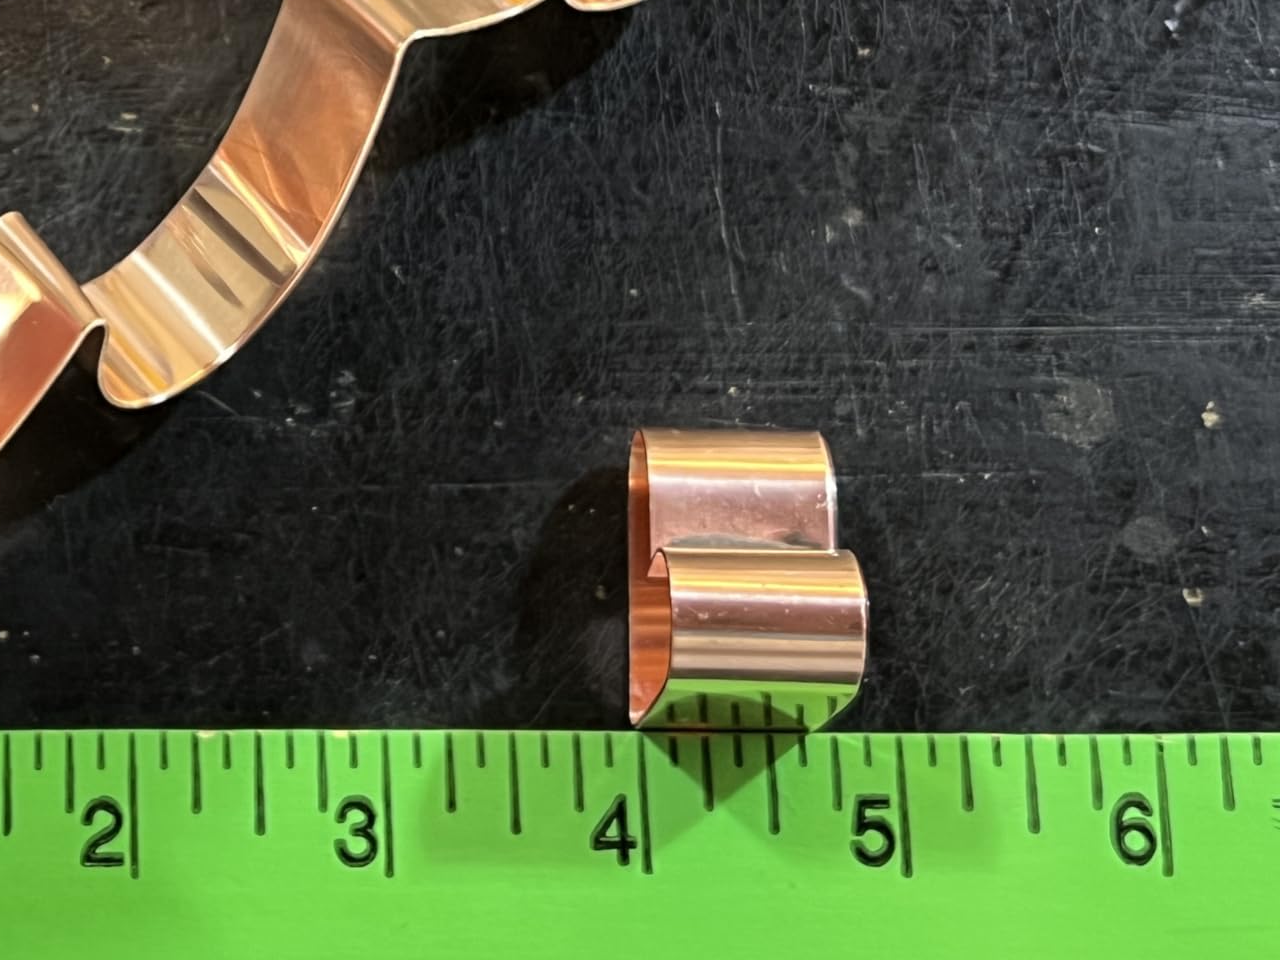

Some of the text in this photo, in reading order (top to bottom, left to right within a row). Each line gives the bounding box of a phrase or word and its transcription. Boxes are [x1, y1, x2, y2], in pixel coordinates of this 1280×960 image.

[79, 796, 126, 869] 2
[334, 795, 379, 869] 3
[589, 793, 638, 867] 4
[849, 793, 897, 868] 5
[1109, 792, 1158, 867] 6
